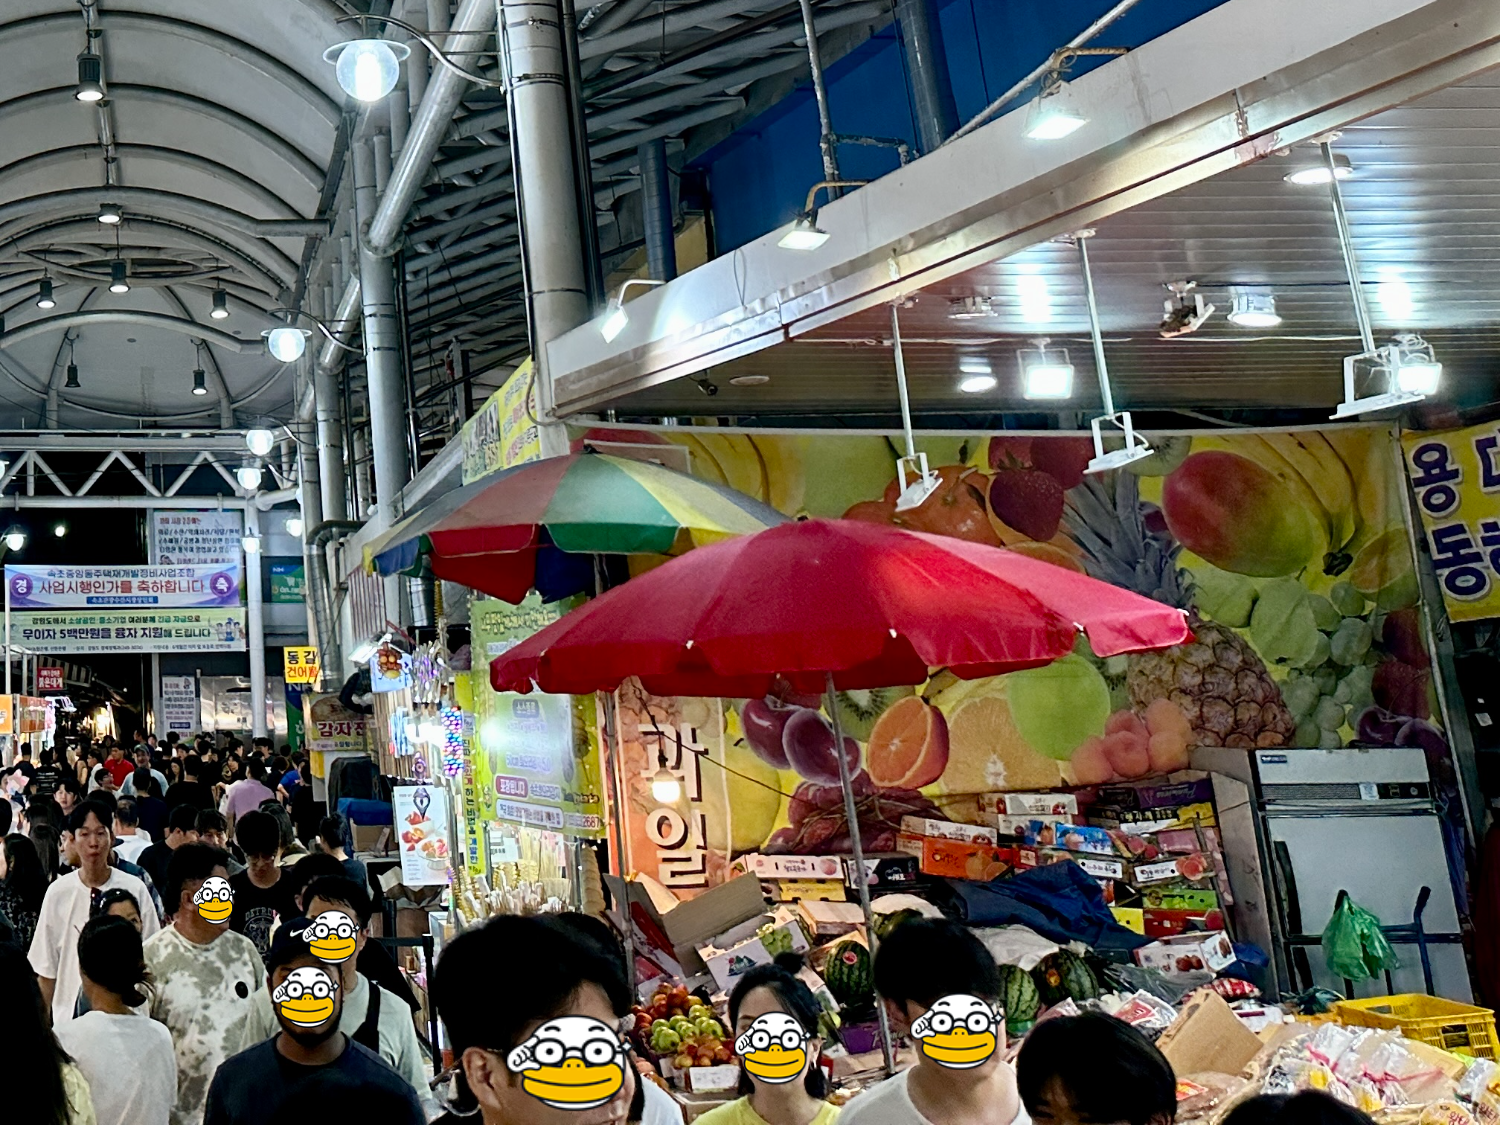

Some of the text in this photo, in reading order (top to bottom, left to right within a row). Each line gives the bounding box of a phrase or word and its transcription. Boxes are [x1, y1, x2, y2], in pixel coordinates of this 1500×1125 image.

[16, 578, 27, 594] 경
[39, 579, 205, 594] 사업시행인가를 축하합니다
[216, 577, 229, 592] 축
[22, 628, 57, 640] 무이자
[59, 627, 112, 640] 5백만원을
[114, 627, 138, 640] 융자
[174, 627, 211, 638] 드립니다
[638, 722, 709, 888] 과일
